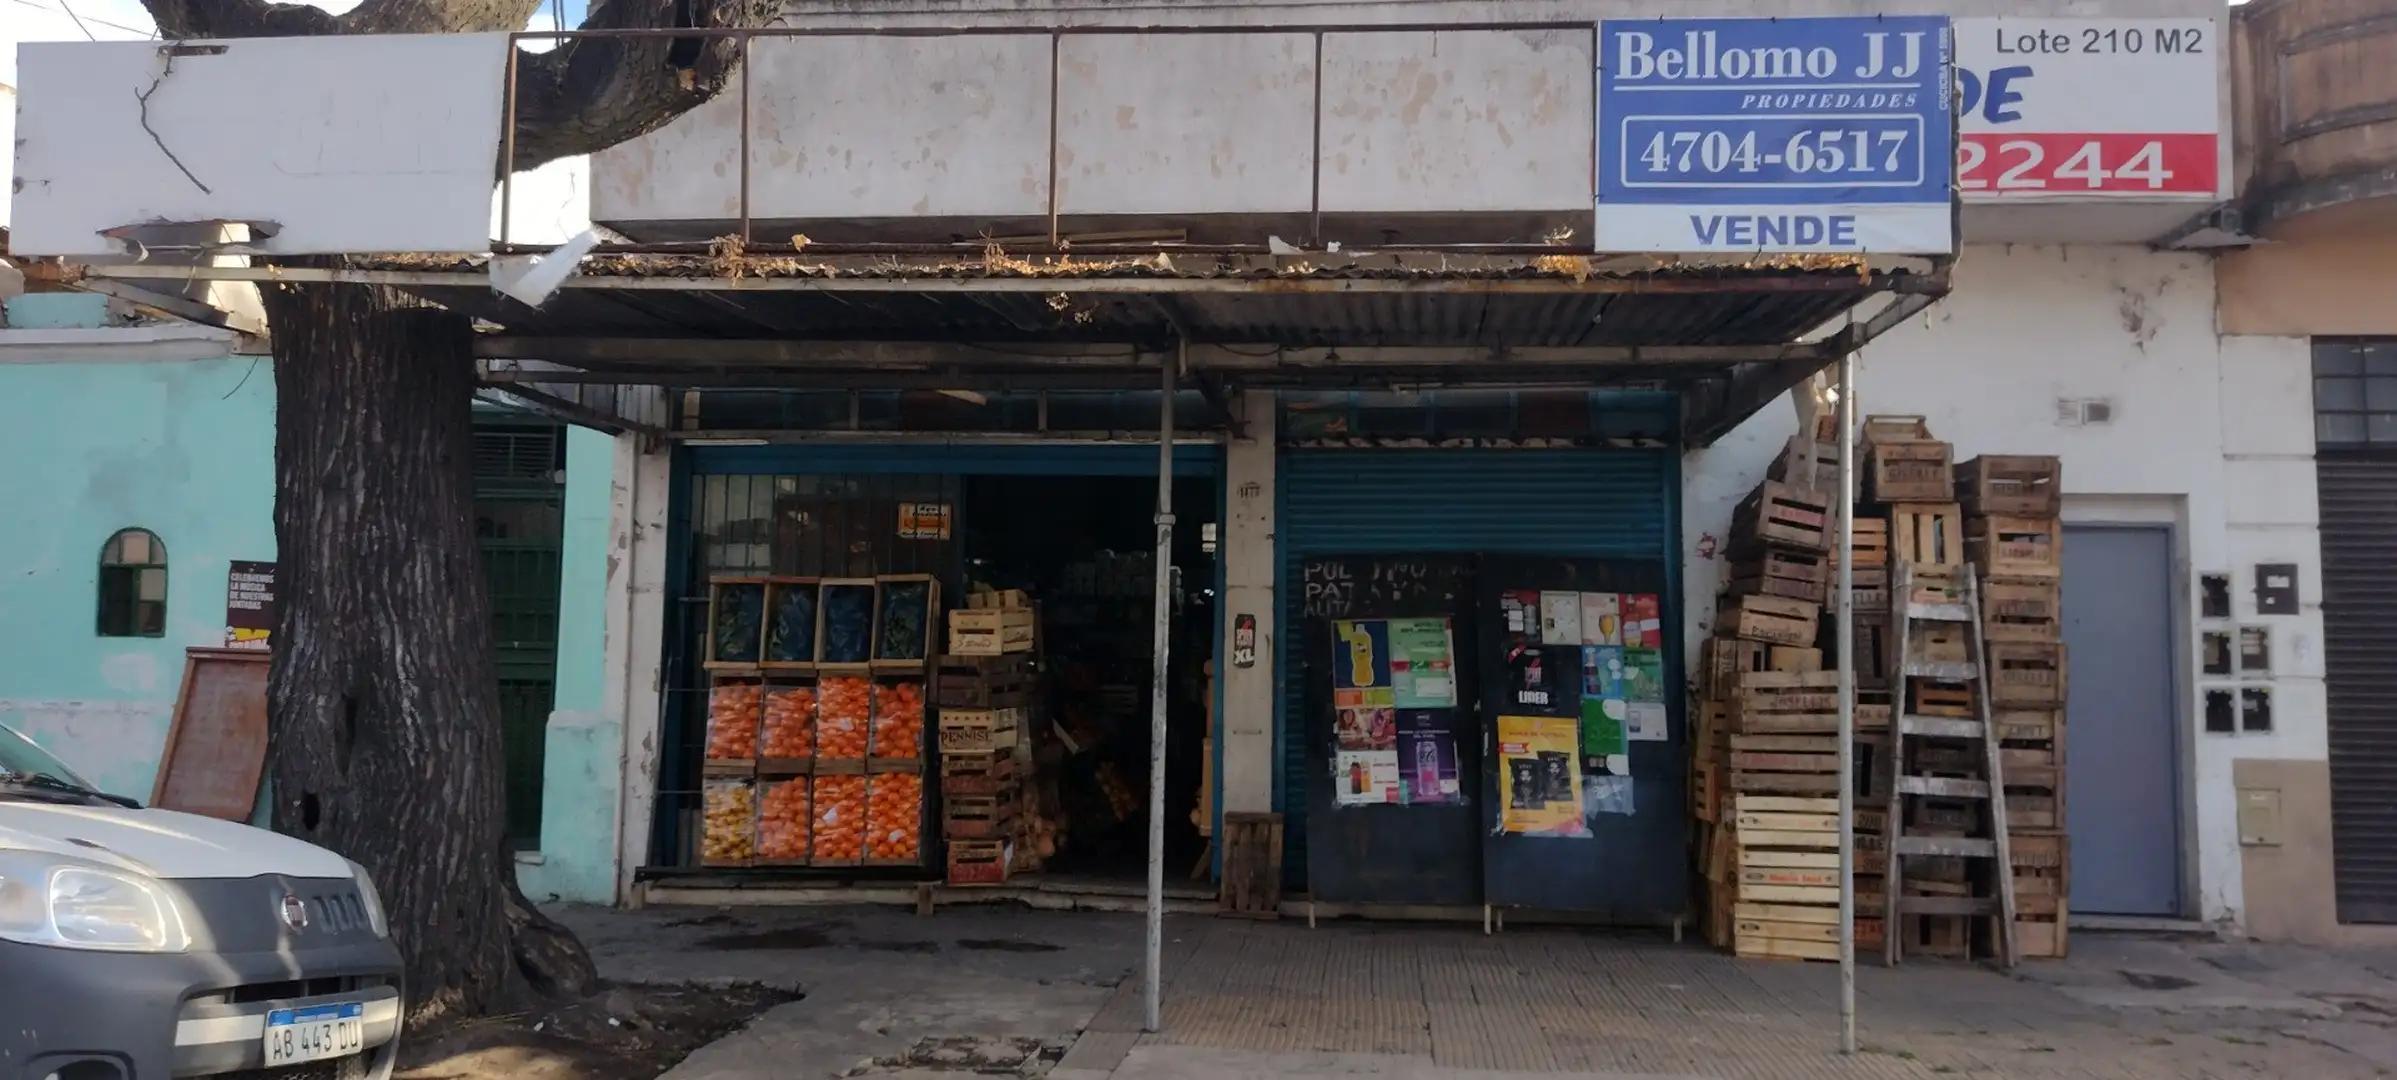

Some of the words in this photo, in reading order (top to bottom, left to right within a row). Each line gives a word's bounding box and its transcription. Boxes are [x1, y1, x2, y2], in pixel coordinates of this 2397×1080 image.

[1614, 30, 1837, 79] Bellomo
[1855, 32, 1926, 79] JJ
[1996, 28, 2071, 53] Lote
[2082, 28, 2142, 53] 210
[2155, 28, 2203, 54] M2
[1741, 92, 1918, 109] PROPIEDADES
[1641, 129, 1909, 173] 4704-6517
[1690, 214, 1857, 246] VENDE
[1234, 649, 1255, 664] XL
[273, 1029, 294, 1060] AB
[301, 1024, 332, 1054] 443
